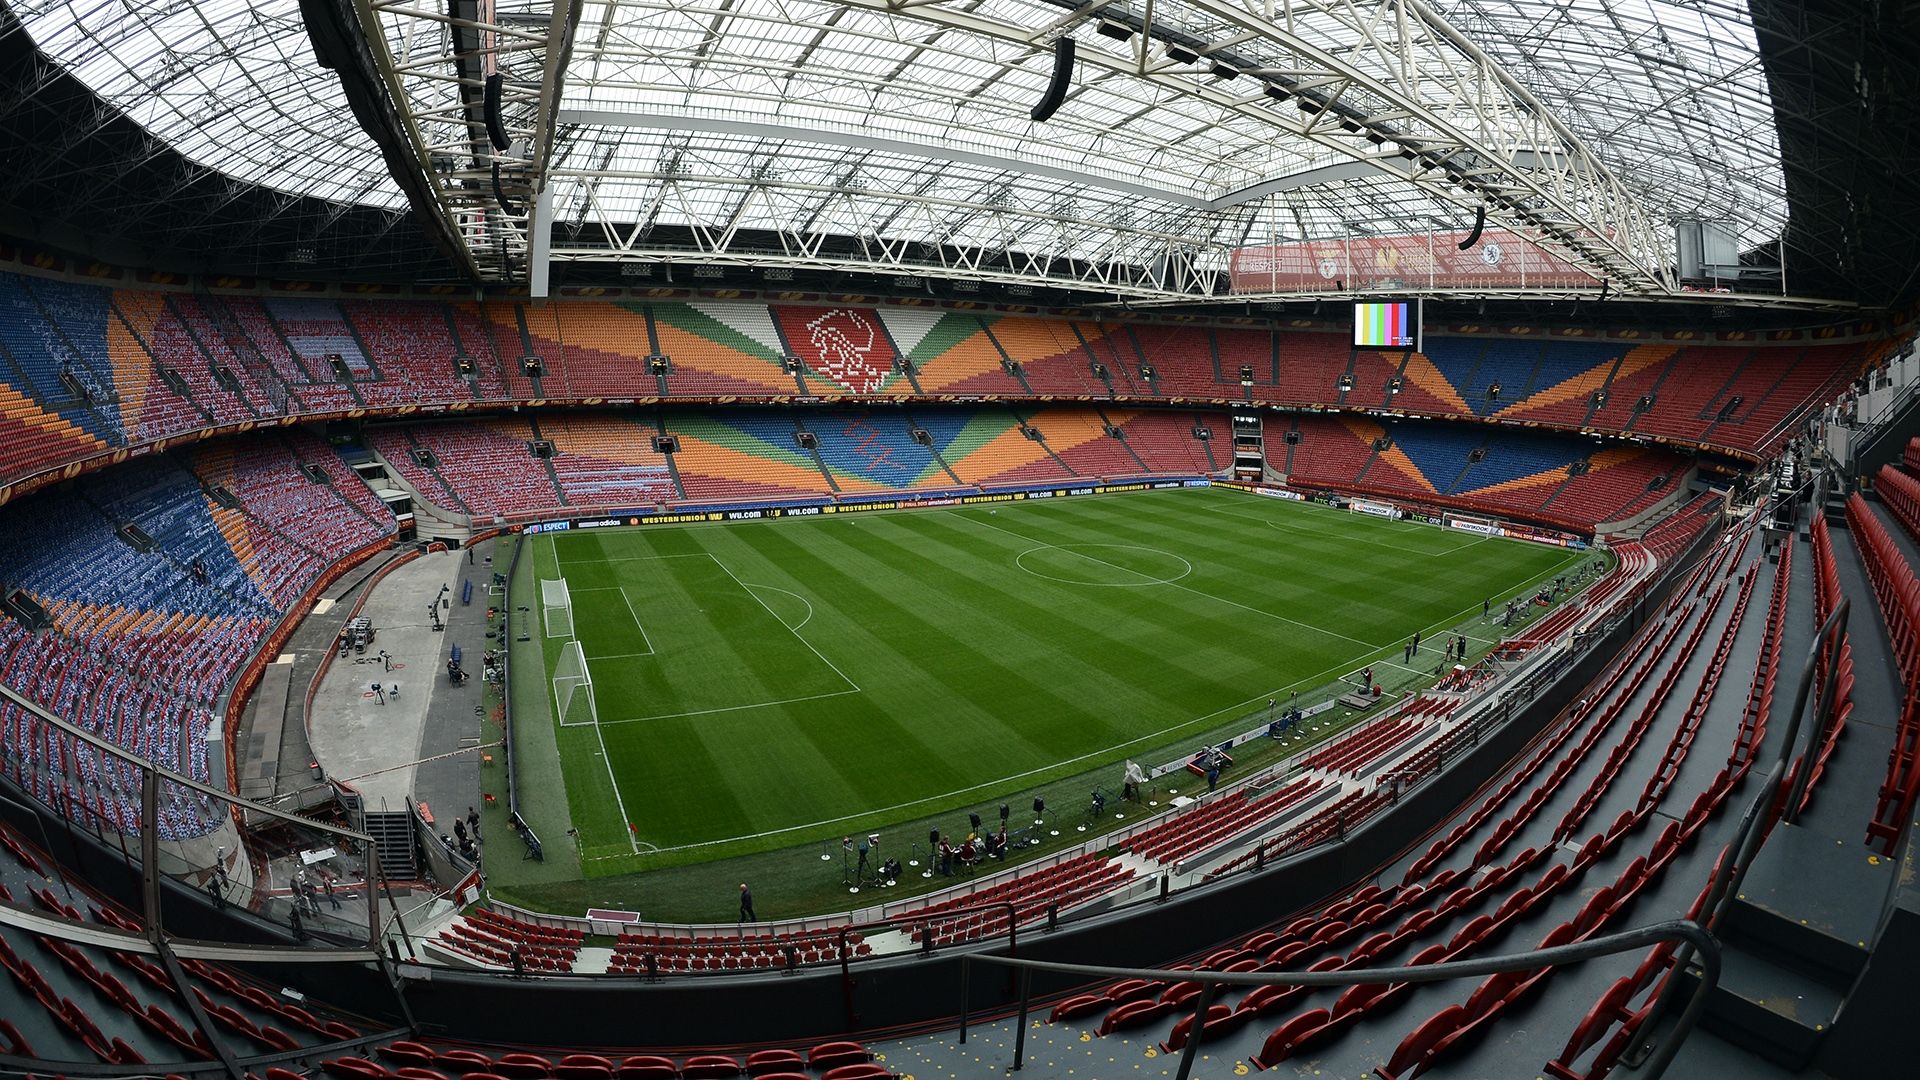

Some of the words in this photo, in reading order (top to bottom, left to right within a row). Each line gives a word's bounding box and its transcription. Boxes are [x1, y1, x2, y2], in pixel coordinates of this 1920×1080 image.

[1028, 491, 1052, 499] wu.com
[788, 507, 818, 516] wu.com
[838, 505, 871, 513] WESTERN
[642, 516, 679, 524] WESTERN
[680, 514, 706, 522] UNION
[729, 510, 761, 519] wu.com
[1533, 536, 1560, 545] amsterdam
